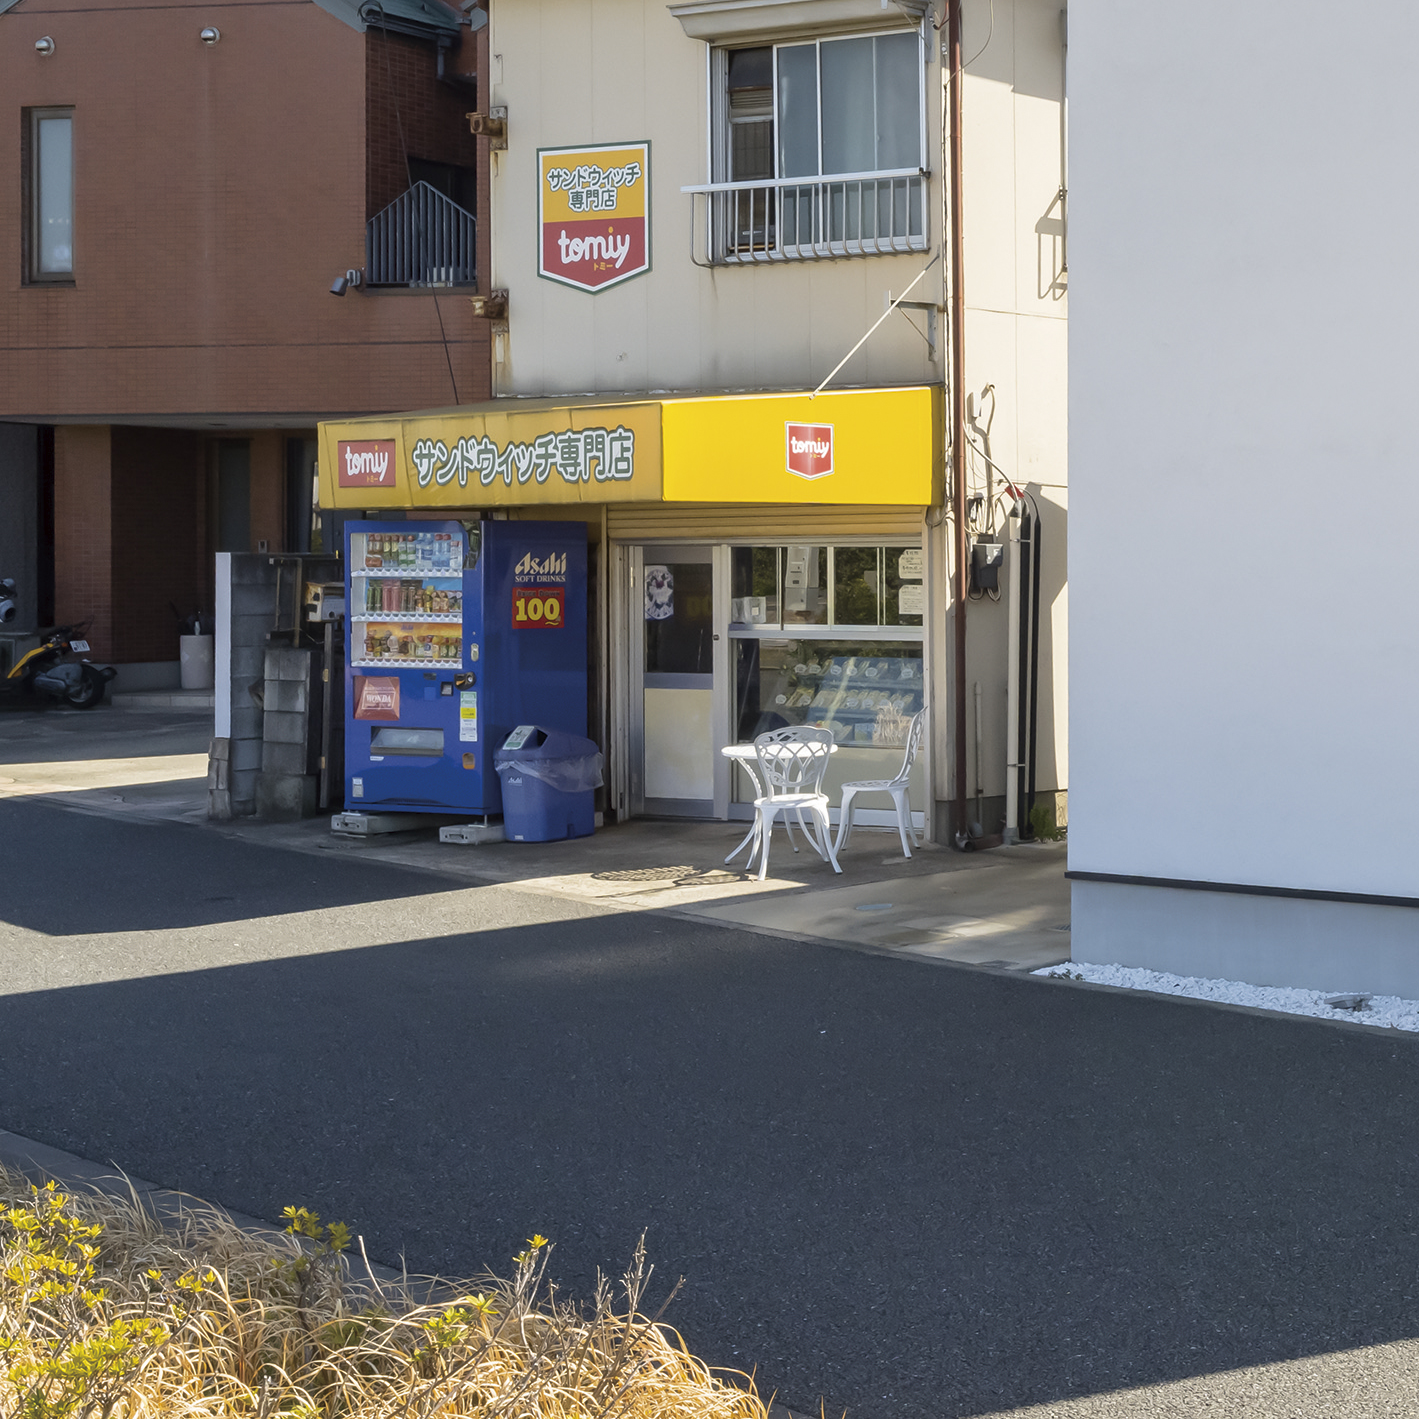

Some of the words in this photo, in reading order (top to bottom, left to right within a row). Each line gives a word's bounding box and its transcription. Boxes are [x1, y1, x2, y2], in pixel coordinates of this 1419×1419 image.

[547, 162, 642, 192] サンドウィッチ
[568, 187, 617, 213] 専門店
[557, 226, 631, 269] tomiy
[593, 262, 614, 271] トミー
[412, 425, 634, 488] サンドウィッチ専門店
[790, 436, 830, 458] tomiy
[345, 444, 389, 482] tomiy
[514, 551, 567, 575] Asahi
[515, 575, 535, 583] SOFT
[536, 575, 566, 583] DRINKS
[515, 597, 560, 621] 100
